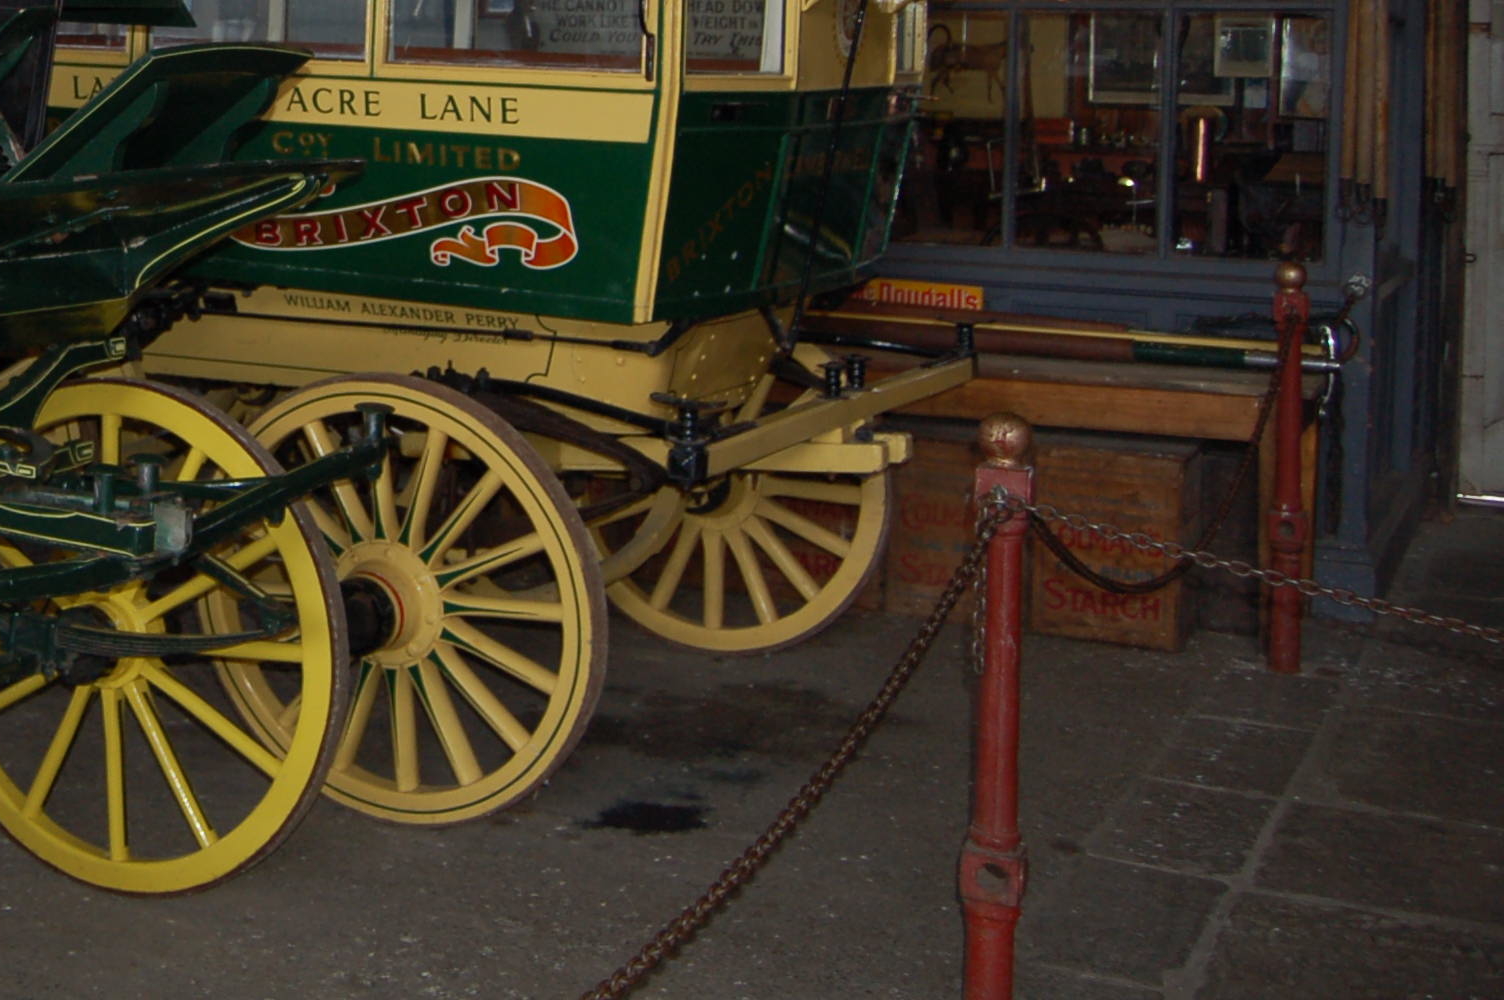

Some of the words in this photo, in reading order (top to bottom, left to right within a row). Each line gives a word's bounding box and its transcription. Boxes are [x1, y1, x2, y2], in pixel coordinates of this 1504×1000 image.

[286, 87, 383, 117] ACRE
[420, 93, 521, 125] LANE
[373, 136, 522, 171] LIMITED
[255, 182, 522, 248] BRIXTON
[283, 293, 352, 313] WILLIAM
[361, 302, 456, 324] ALEXANDER
[466, 312, 520, 330] PERRY
[1042, 578, 1161, 621] STARCH
